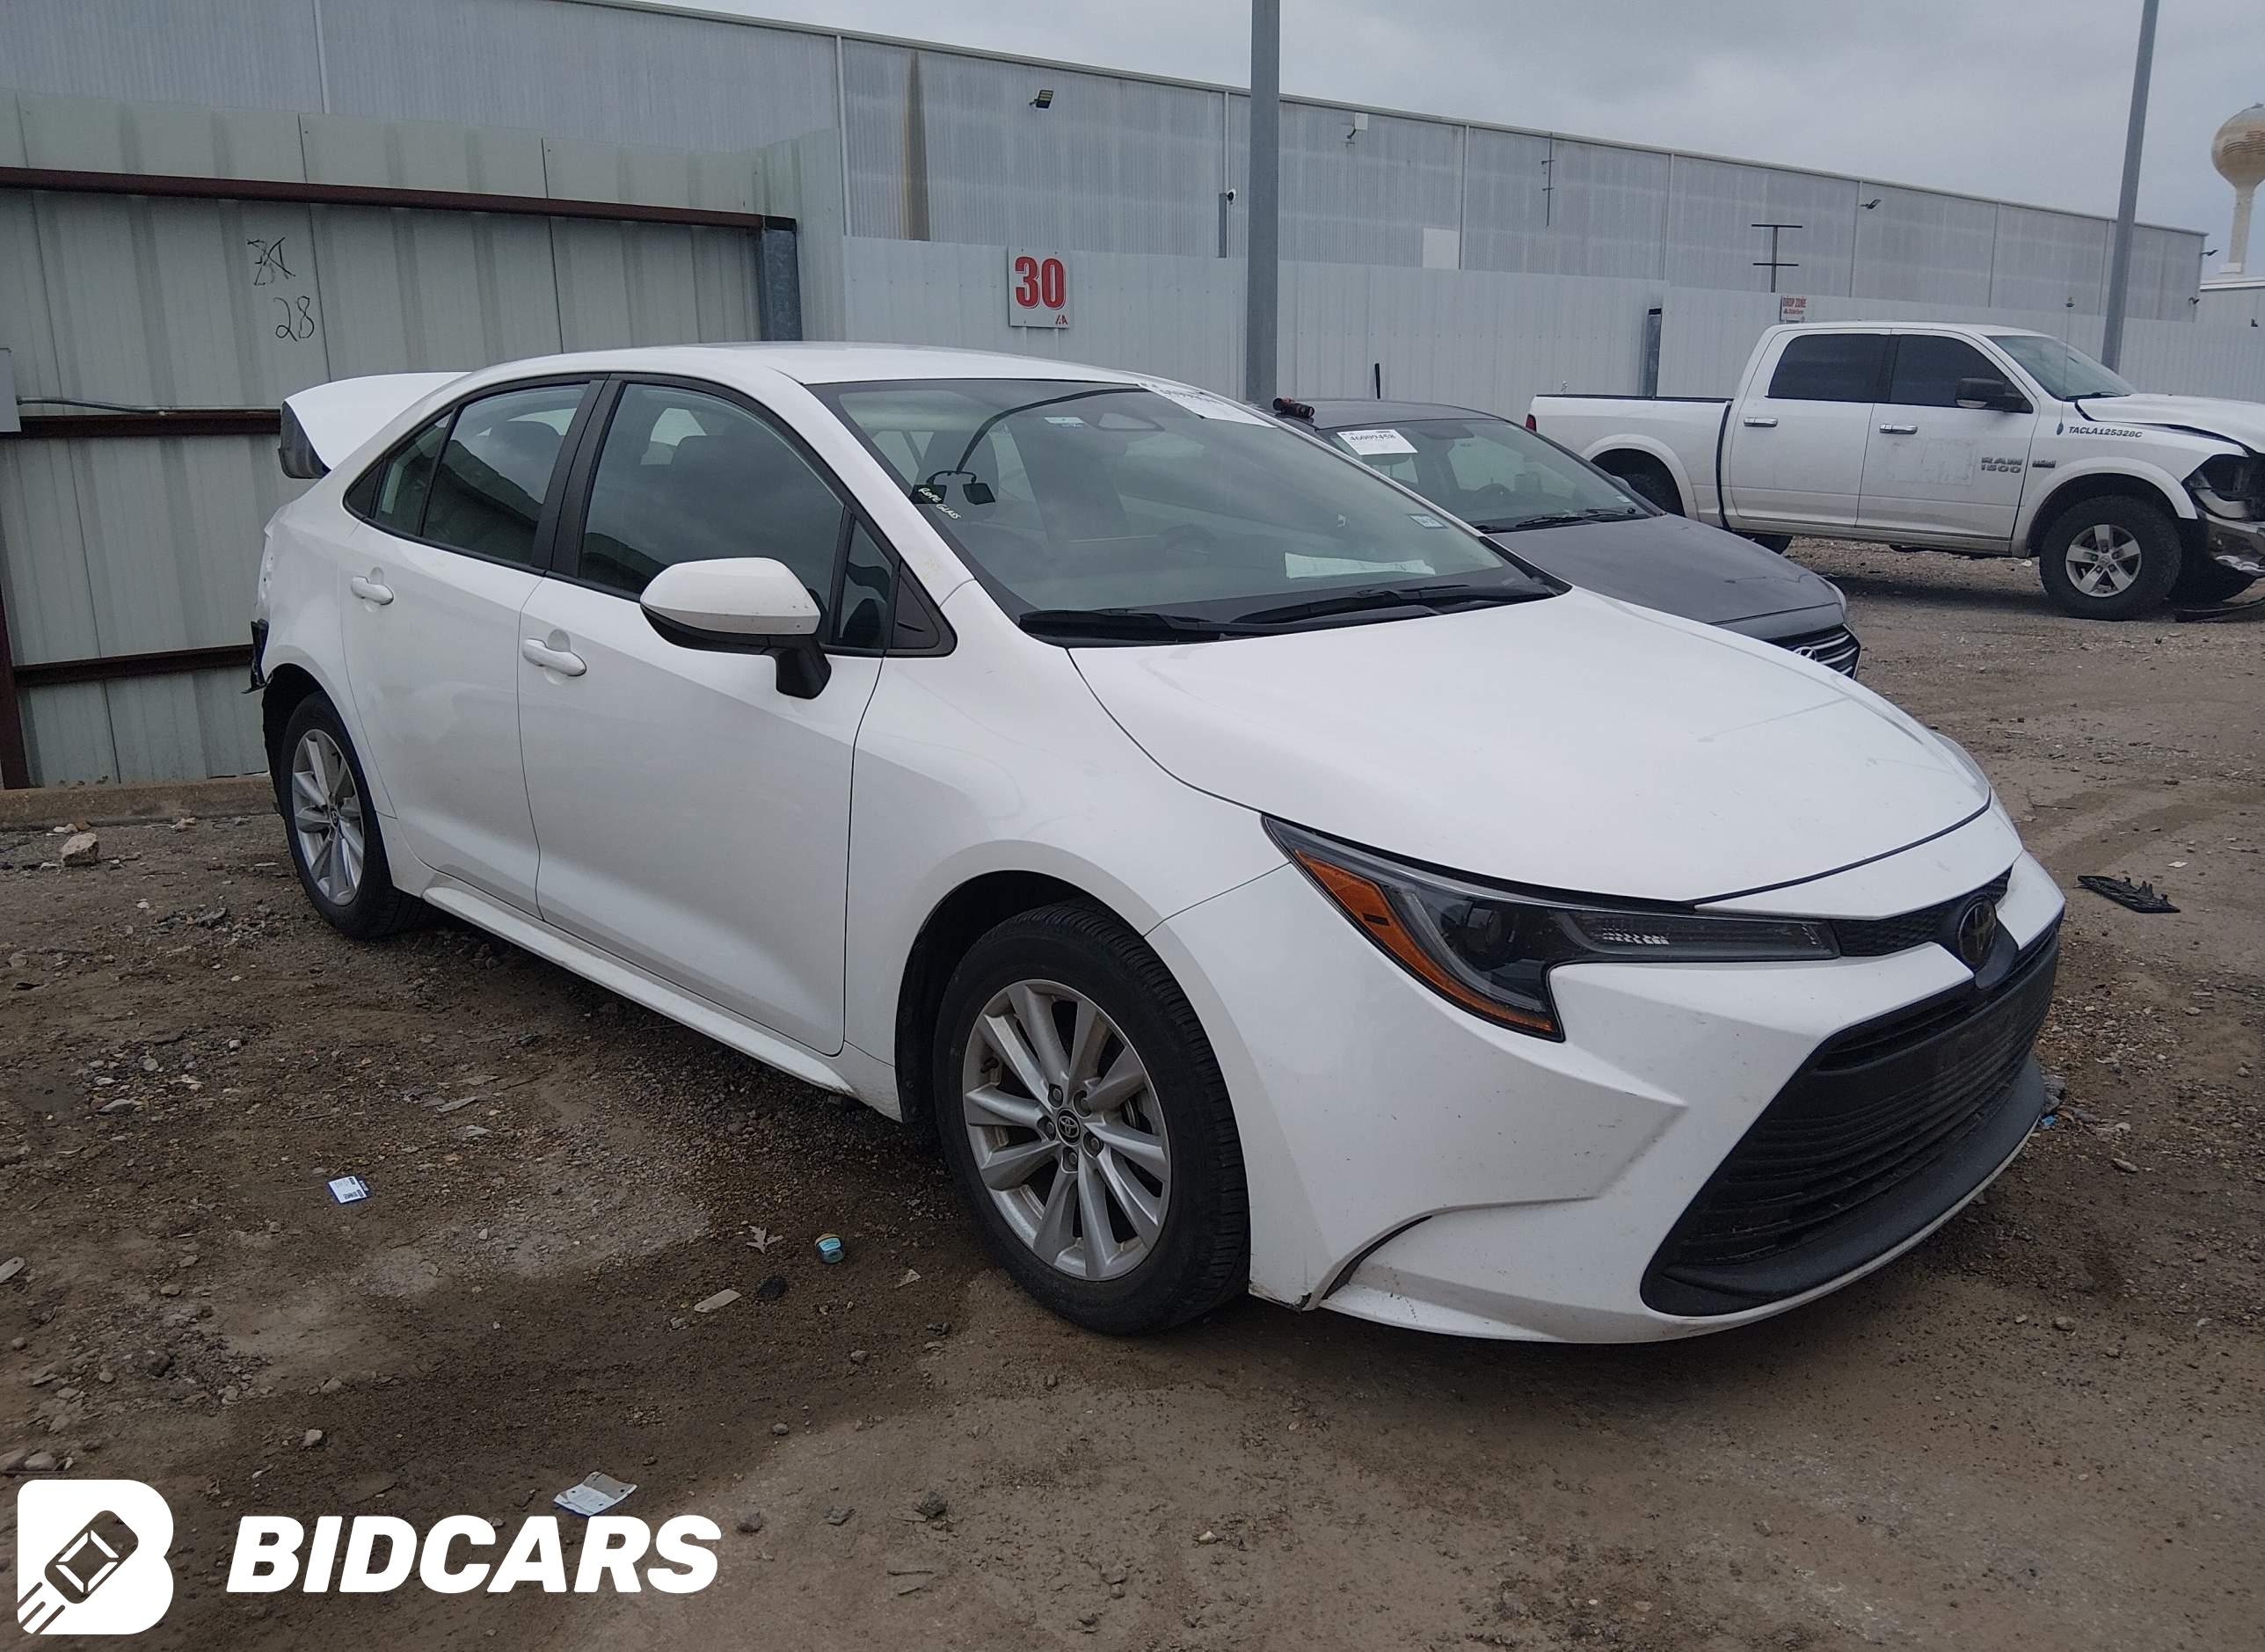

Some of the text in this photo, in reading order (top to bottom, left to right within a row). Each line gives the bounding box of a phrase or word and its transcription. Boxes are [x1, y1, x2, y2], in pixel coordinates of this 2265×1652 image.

[1015, 256, 1067, 310] 30
[273, 295, 315, 342] 28
[1981, 456, 2023, 466] RAM
[1981, 464, 2021, 473] 1500
